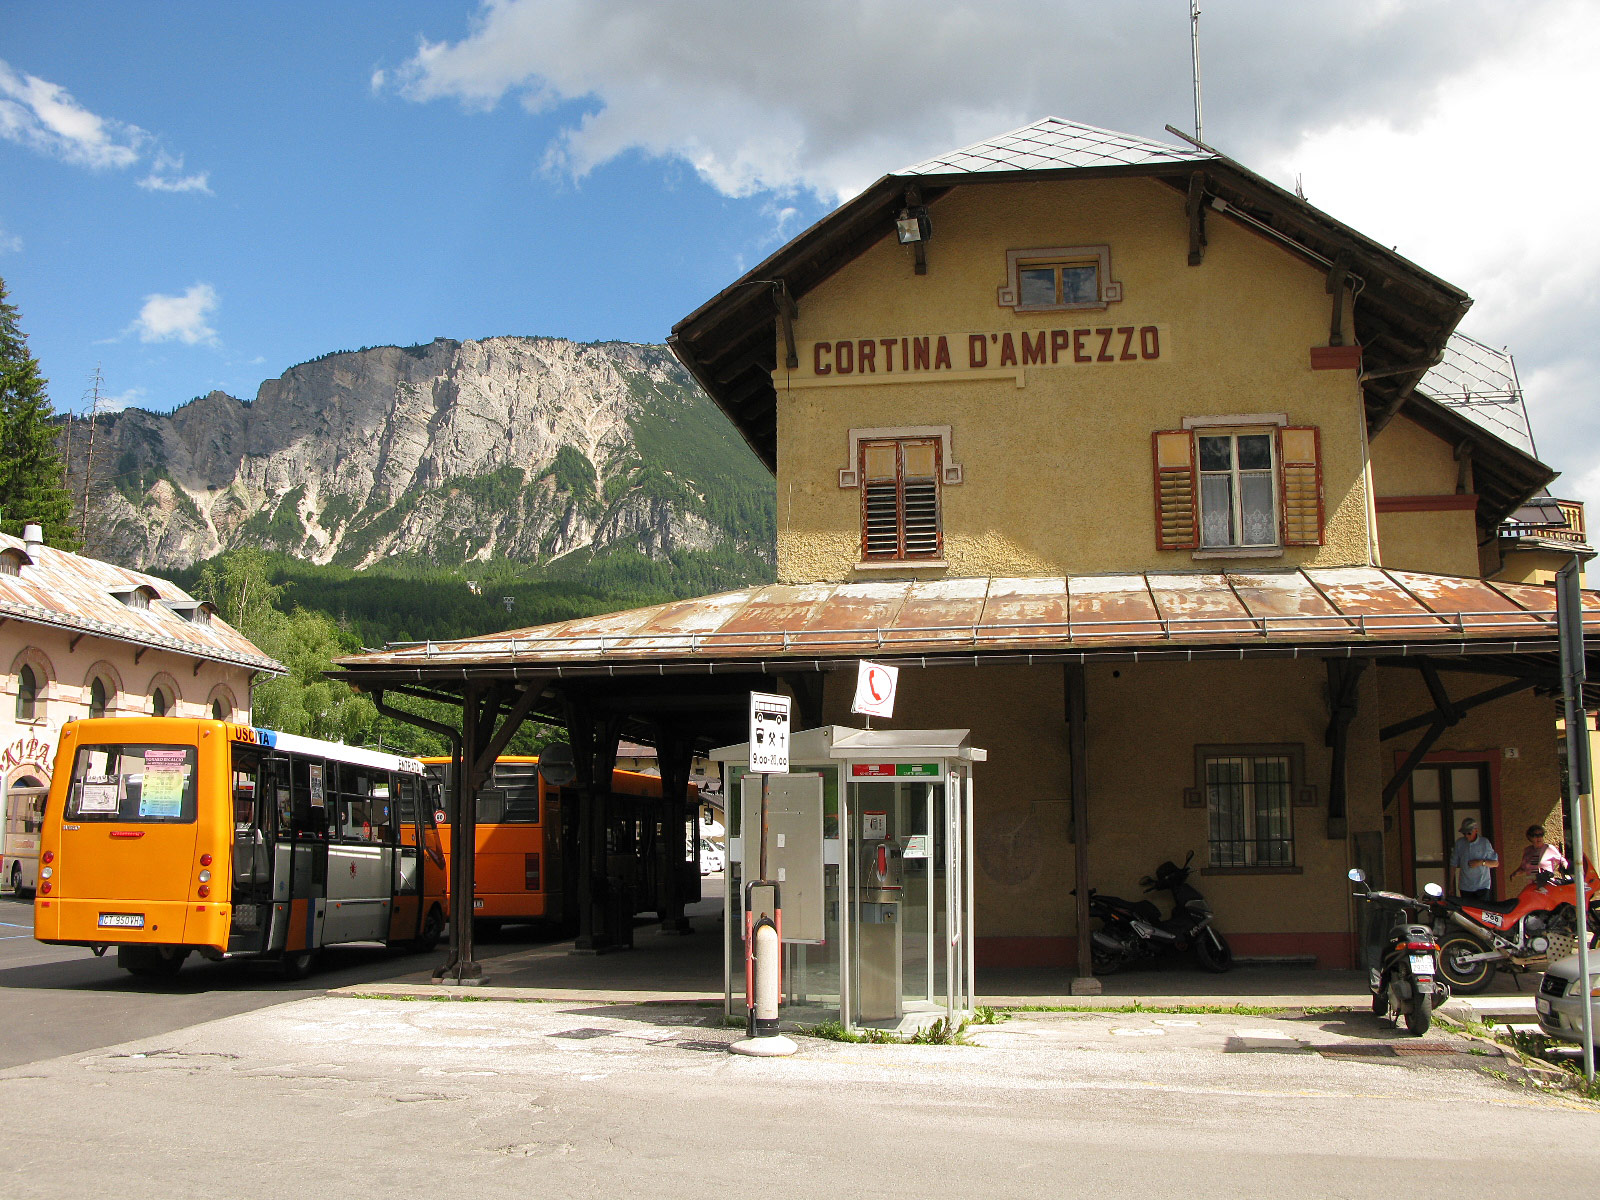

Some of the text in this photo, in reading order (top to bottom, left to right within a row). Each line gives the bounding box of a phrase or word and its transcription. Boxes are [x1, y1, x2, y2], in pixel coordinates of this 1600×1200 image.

[814, 325, 1160, 375] CORTINA D'AMPEZZO
[235, 725, 270, 745] USCITA
[398, 758, 420, 772] ENTRATA
[103, 915, 114, 925] CT
